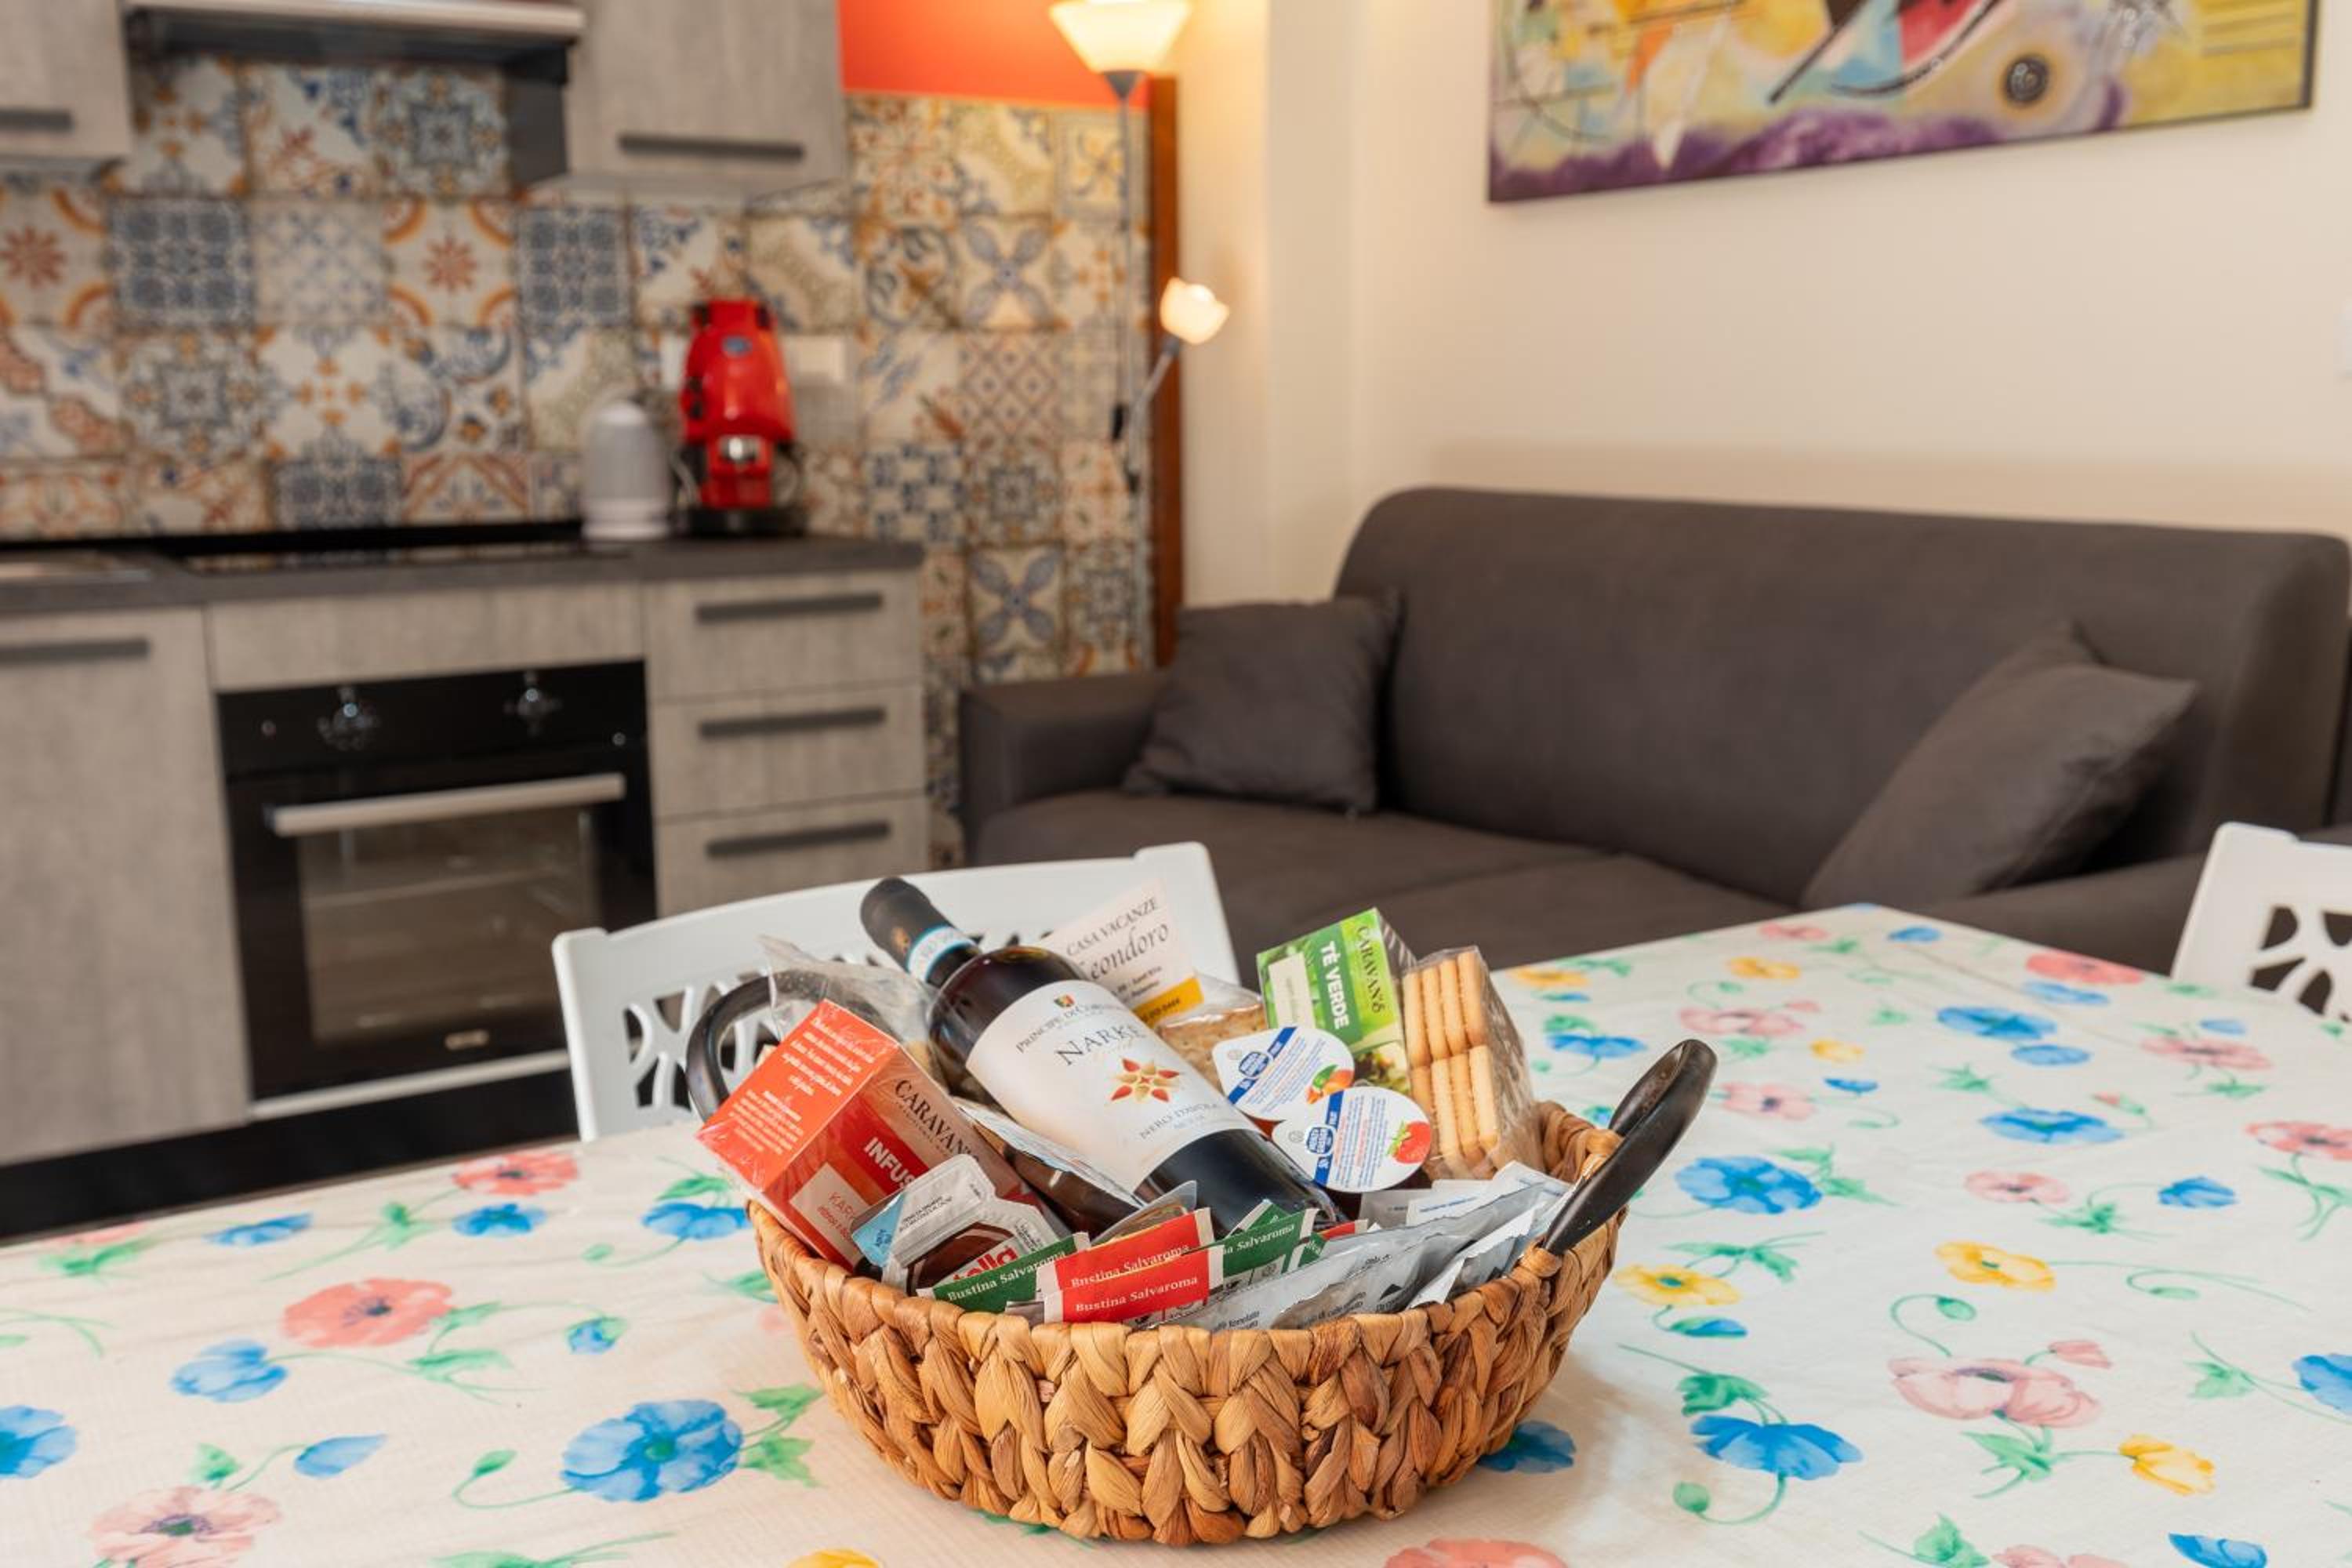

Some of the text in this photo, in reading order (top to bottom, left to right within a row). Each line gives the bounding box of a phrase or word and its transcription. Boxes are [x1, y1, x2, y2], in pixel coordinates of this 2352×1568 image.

[1065, 896, 1158, 957] CASA VACANZE
[1080, 922, 1170, 982] eondoro
[1355, 924, 1387, 1013] CARAVAN'S
[1323, 966, 1351, 1030] VERDE
[862, 1136, 917, 1189] INFUS
[1122, 1242, 1191, 1276] Salvaroma
[1236, 1224, 1295, 1252] Salvaroma
[946, 1250, 1066, 1302] Bustina Salvaroma
[1075, 1278, 1197, 1313] Bustina Salvaroma
